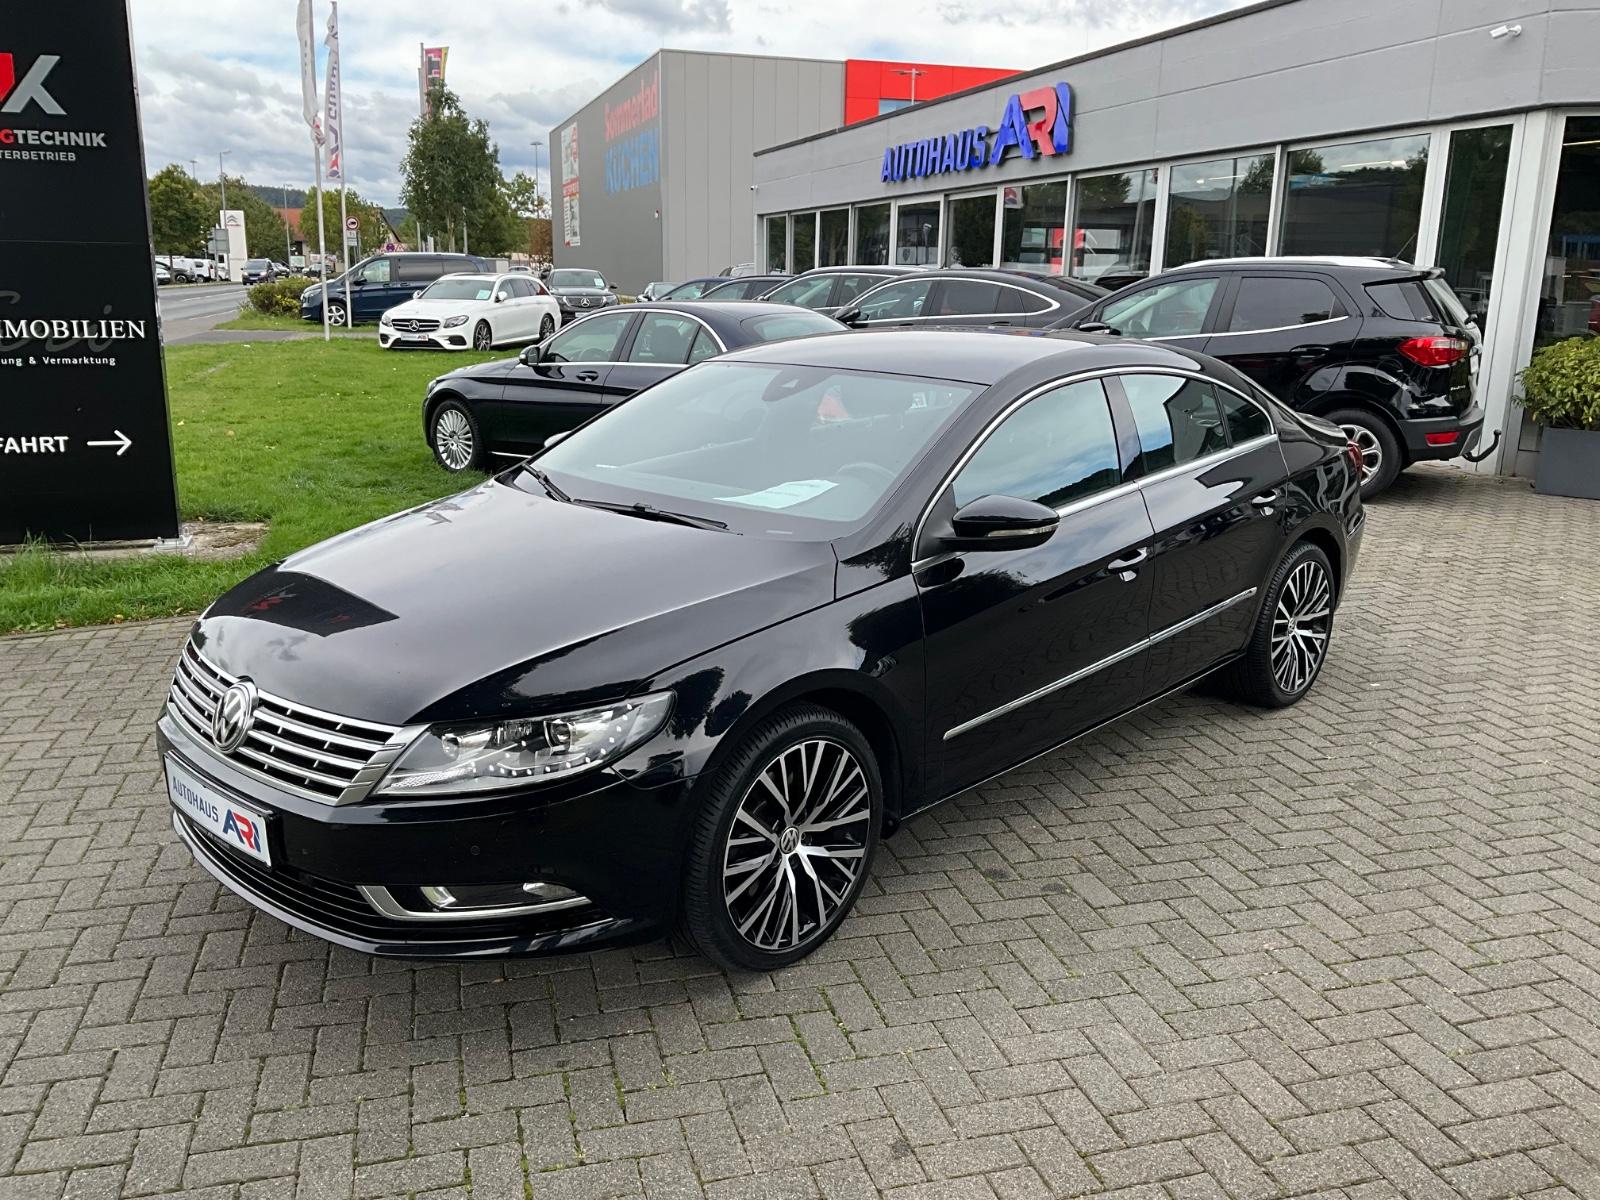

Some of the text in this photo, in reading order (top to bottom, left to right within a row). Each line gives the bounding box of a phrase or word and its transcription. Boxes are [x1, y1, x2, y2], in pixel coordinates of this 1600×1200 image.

[880, 82, 1072, 183] AUTOHAUS ARI
[0, 319, 146, 339] MOBILIEN
[28, 356, 37, 365] &
[42, 356, 116, 366] Vermarktung
[172, 776, 220, 823] AUTOHAUS
[222, 808, 262, 853] ARI
